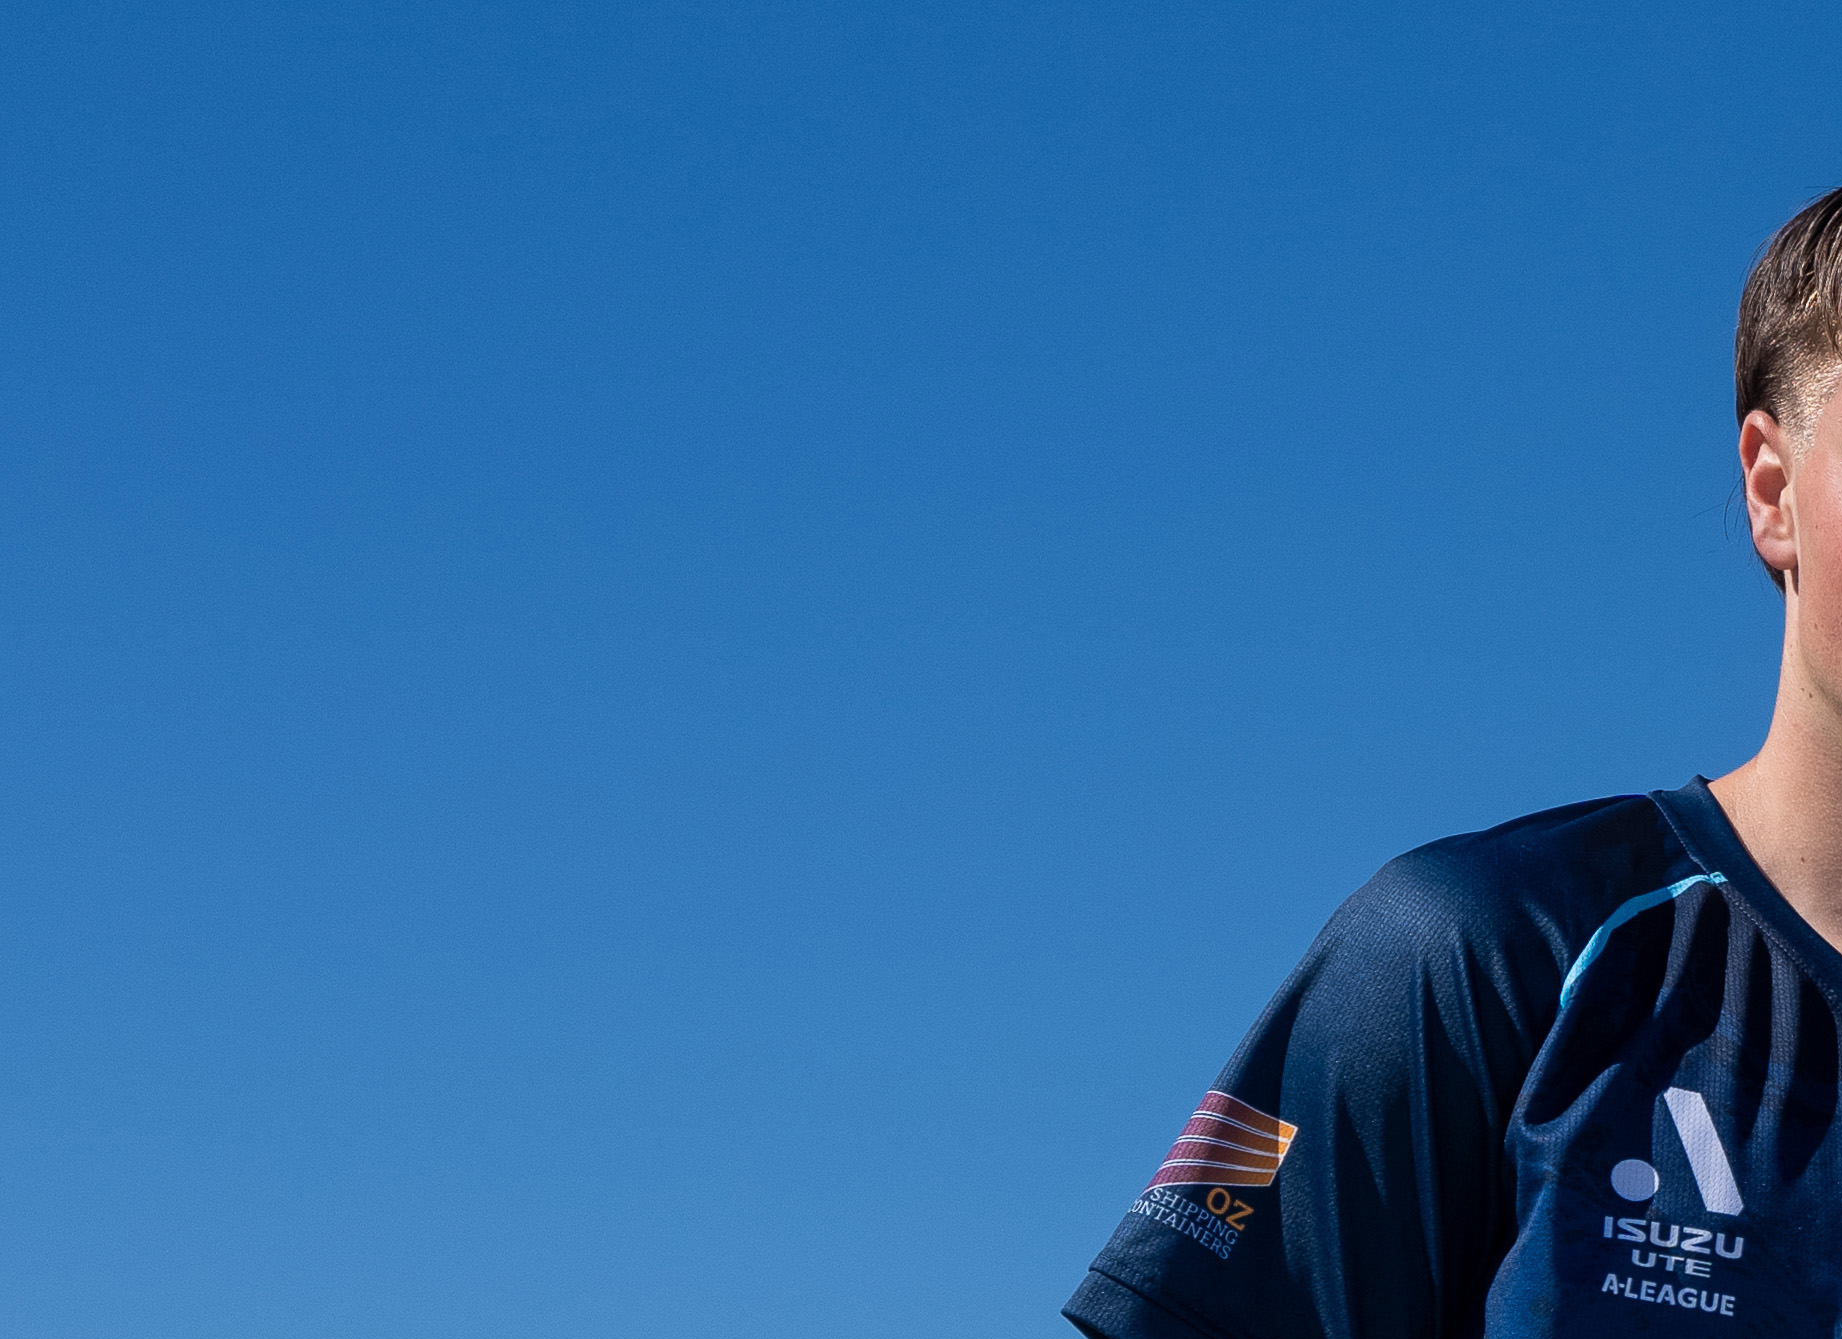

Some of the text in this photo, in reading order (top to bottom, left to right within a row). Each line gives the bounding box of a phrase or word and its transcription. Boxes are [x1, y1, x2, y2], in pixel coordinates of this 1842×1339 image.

[1128, 1199, 1232, 1260] ONTAINERS
[1150, 1187, 1239, 1245] SHIPPING
[1206, 1187, 1254, 1232] OZ
[1603, 1215, 1745, 1260] ISUZU
[1631, 1248, 1712, 1278] UTE
[1601, 1273, 1736, 1317] A-LEAGUE
